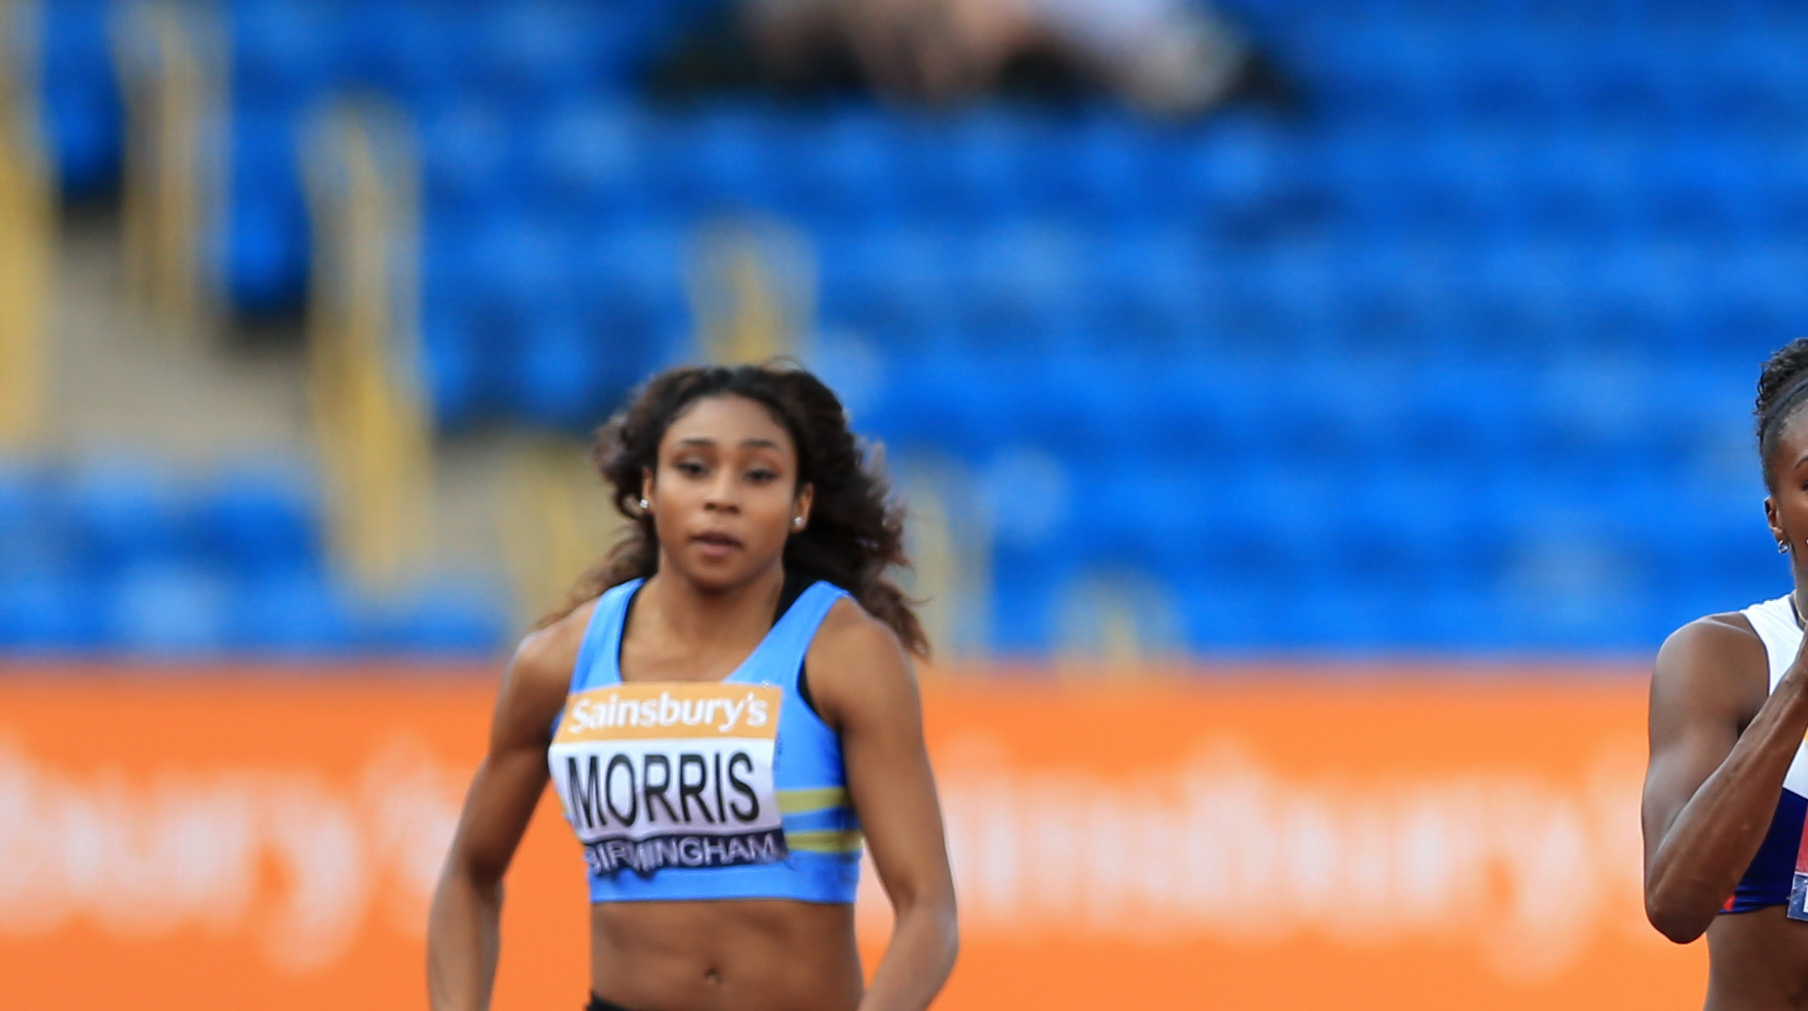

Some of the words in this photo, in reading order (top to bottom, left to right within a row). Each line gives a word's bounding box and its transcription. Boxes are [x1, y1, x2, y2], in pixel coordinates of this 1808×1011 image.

[567, 691, 768, 734] Sainsbury's
[567, 751, 760, 829] MORRIS
[586, 833, 775, 873] BIRMINGHAM
